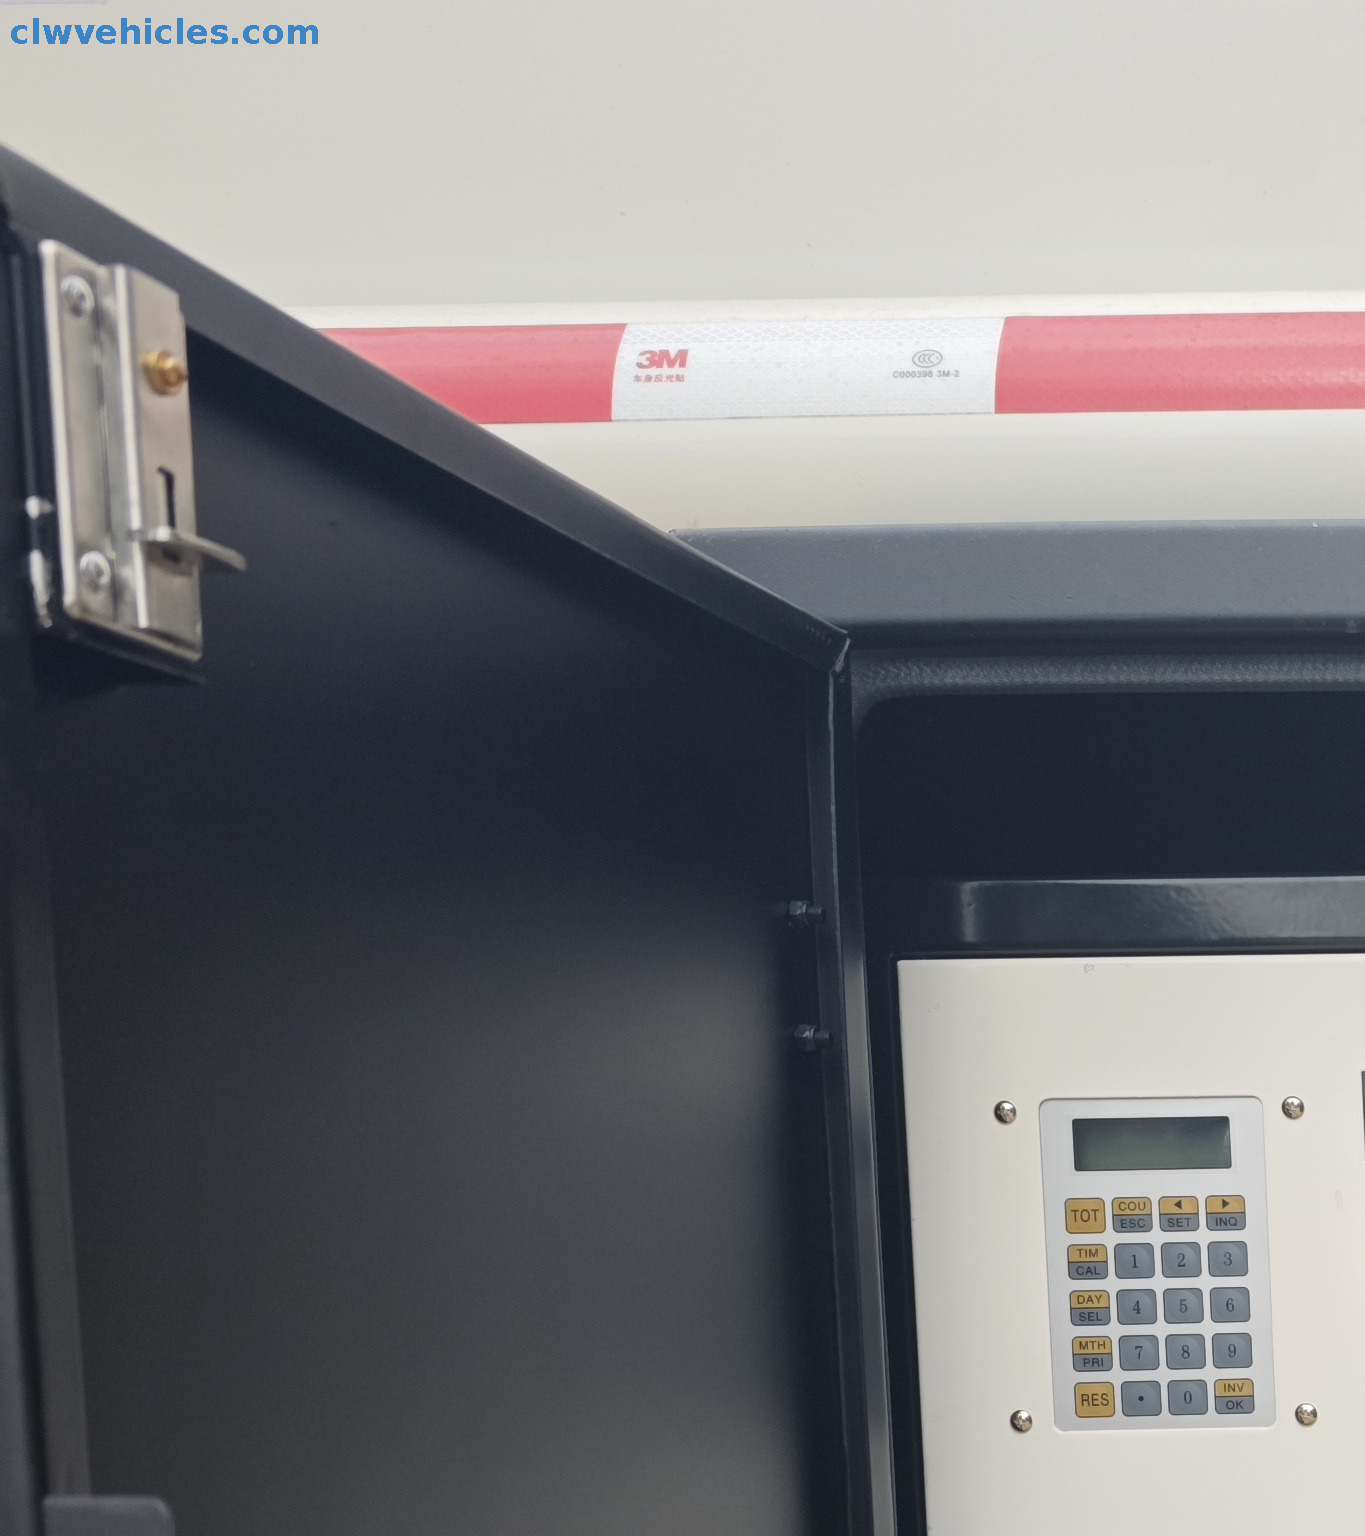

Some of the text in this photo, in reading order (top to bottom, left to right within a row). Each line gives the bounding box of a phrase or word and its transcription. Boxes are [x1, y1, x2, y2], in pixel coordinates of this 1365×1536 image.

[635, 349, 689, 370] 3M
[892, 370, 933, 378] C000398
[1118, 1201, 1146, 1212] COU
[1070, 1209, 1100, 1223] TOT
[1167, 1217, 1192, 1228] SET
[1215, 1216, 1238, 1228] INQ
[1120, 1218, 1146, 1229] ESC
[1078, 1248, 1099, 1259] TIM
[1177, 1253, 1186, 1267] 2
[1223, 1252, 1232, 1266] 3
[1131, 1254, 1138, 1268] 1
[1076, 1266, 1101, 1276] CAL
[1077, 1294, 1102, 1305] DAY
[1179, 1299, 1188, 1313] 5
[1226, 1298, 1234, 1312] 6
[1132, 1300, 1141, 1314] 4
[1078, 1311, 1103, 1322] SEL
[1078, 1340, 1106, 1351] MTH
[1181, 1345, 1190, 1359] 8
[1228, 1344, 1236, 1358] 9
[1135, 1346, 1143, 1360] 7
[1083, 1357, 1104, 1368] PRI
[1223, 1383, 1244, 1393] INV
[1081, 1393, 1109, 1407] RES
[1184, 1391, 1192, 1405] 0
[1226, 1400, 1244, 1410] OK
